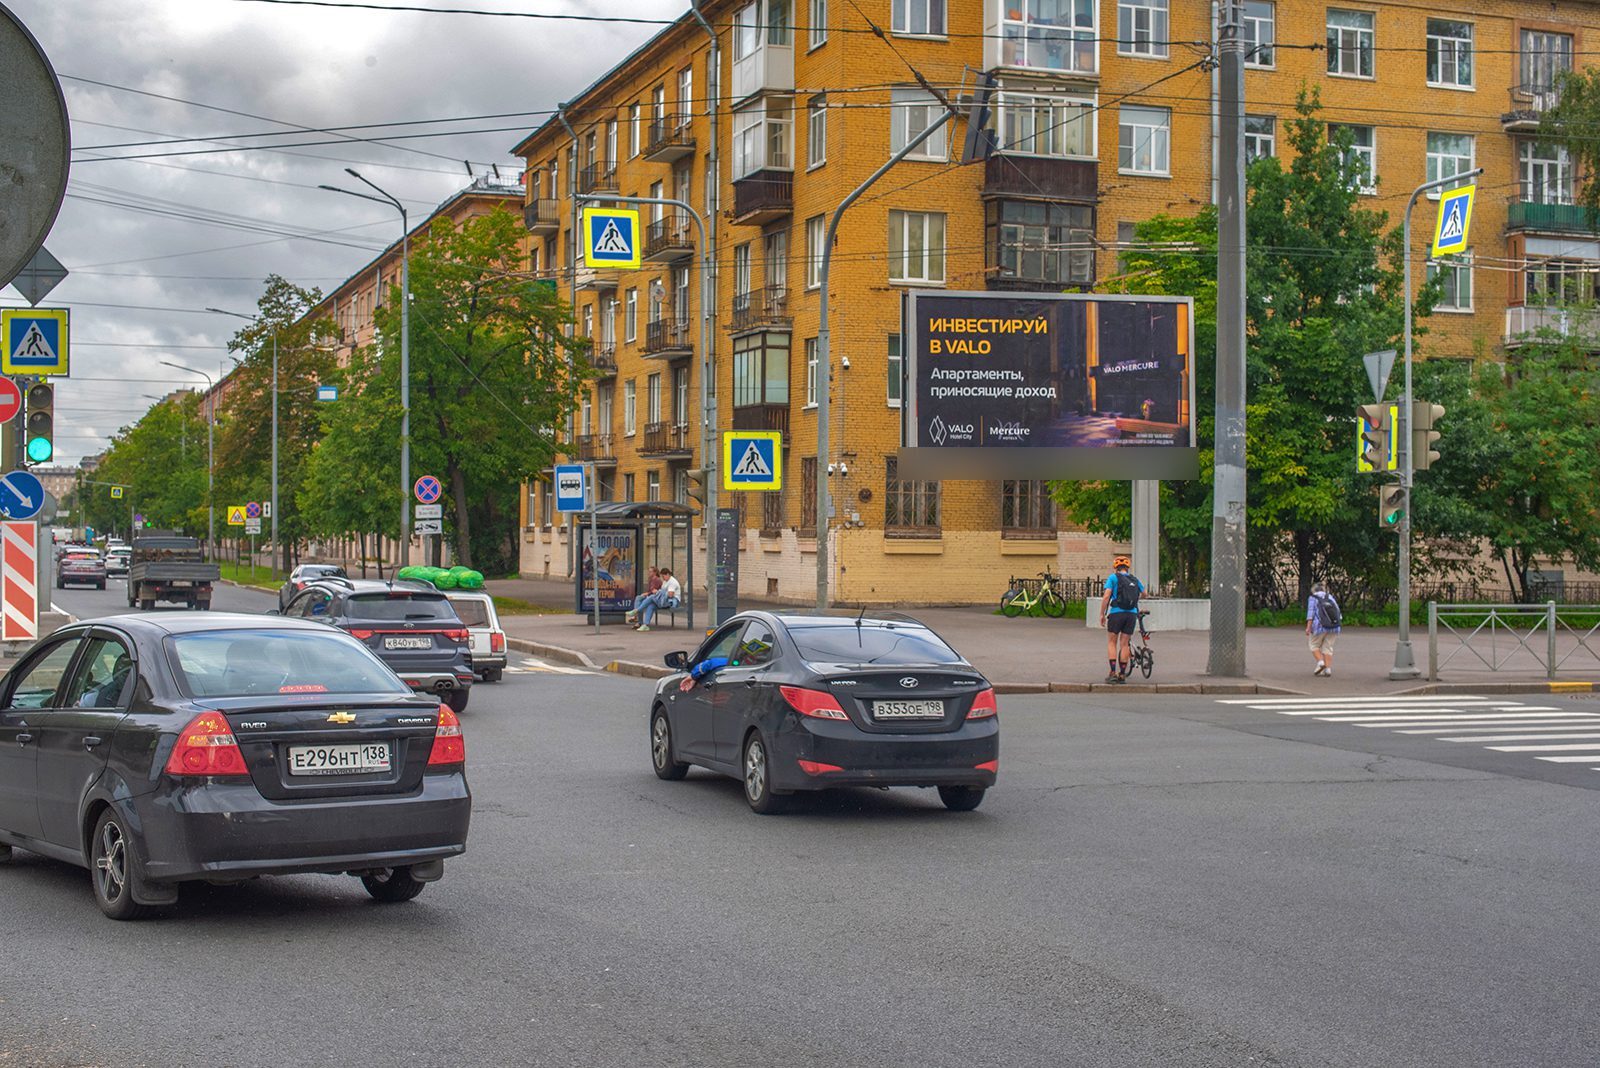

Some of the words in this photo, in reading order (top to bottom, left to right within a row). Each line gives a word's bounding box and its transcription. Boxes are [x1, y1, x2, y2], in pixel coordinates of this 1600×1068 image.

[929, 315, 1047, 334] ИНВЕСТИРУЙ
[929, 339, 942, 354] В
[945, 339, 991, 354] VALO
[1103, 365, 1121, 374] VALO
[1121, 361, 1159, 372] MERCURE
[930, 367, 1025, 382] Апартаменты,
[930, 386, 1013, 399] приносящие
[1015, 386, 1057, 398] доход
[948, 424, 974, 433] VALO
[989, 425, 1030, 436] Mercure
[963, 433, 972, 441] City
[878, 702, 923, 715] В353ОЕ
[925, 702, 941, 711] 198
[295, 748, 359, 768] Е296НТ
[362, 746, 385, 760] 138
